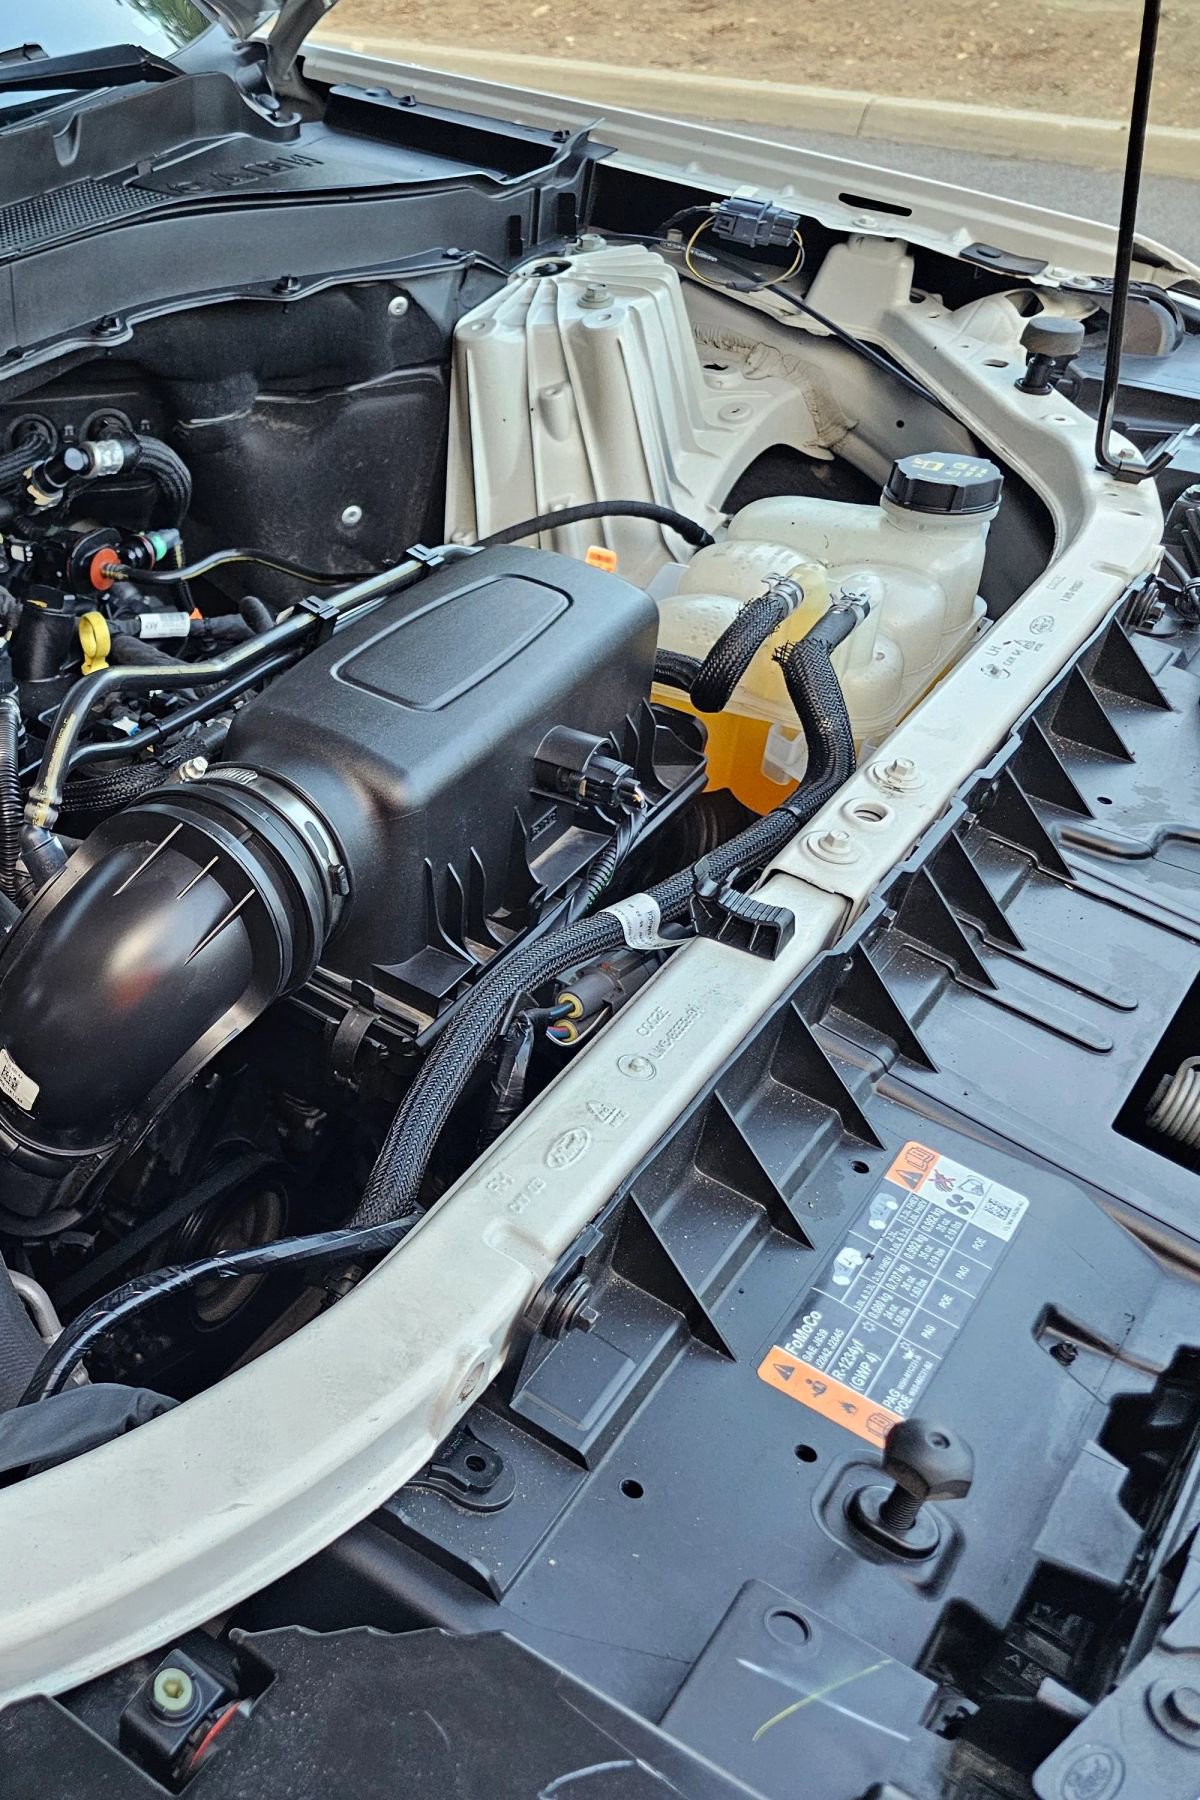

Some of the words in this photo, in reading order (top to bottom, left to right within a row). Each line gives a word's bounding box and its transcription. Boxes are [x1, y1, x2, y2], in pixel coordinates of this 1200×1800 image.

[921, 1214, 938, 1232] 0.992
[931, 1206, 945, 1217] kg
[903, 1240, 921, 1259] 0.992
[914, 1233, 928, 1244] kg
[972, 1236, 986, 1250] POE
[885, 1271, 902, 1289] 0.737
[896, 1263, 910, 1274] kg
[955, 1265, 969, 1279] PAG
[878, 1291, 893, 1303] kg
[938, 1294, 952, 1308] POE
[784, 1308, 822, 1355] FoMoCo
[826, 1328, 843, 1348] J2845
[921, 1324, 935, 1338] PAG
[802, 1345, 817, 1361] SAE
[811, 1328, 827, 1346] J639
[831, 1338, 867, 1382] R-1234yf
[848, 1360, 875, 1391] (GWP
[864, 1351, 881, 1364] 4)
[882, 1388, 900, 1408] PAG
[894, 1394, 912, 1414] POE
